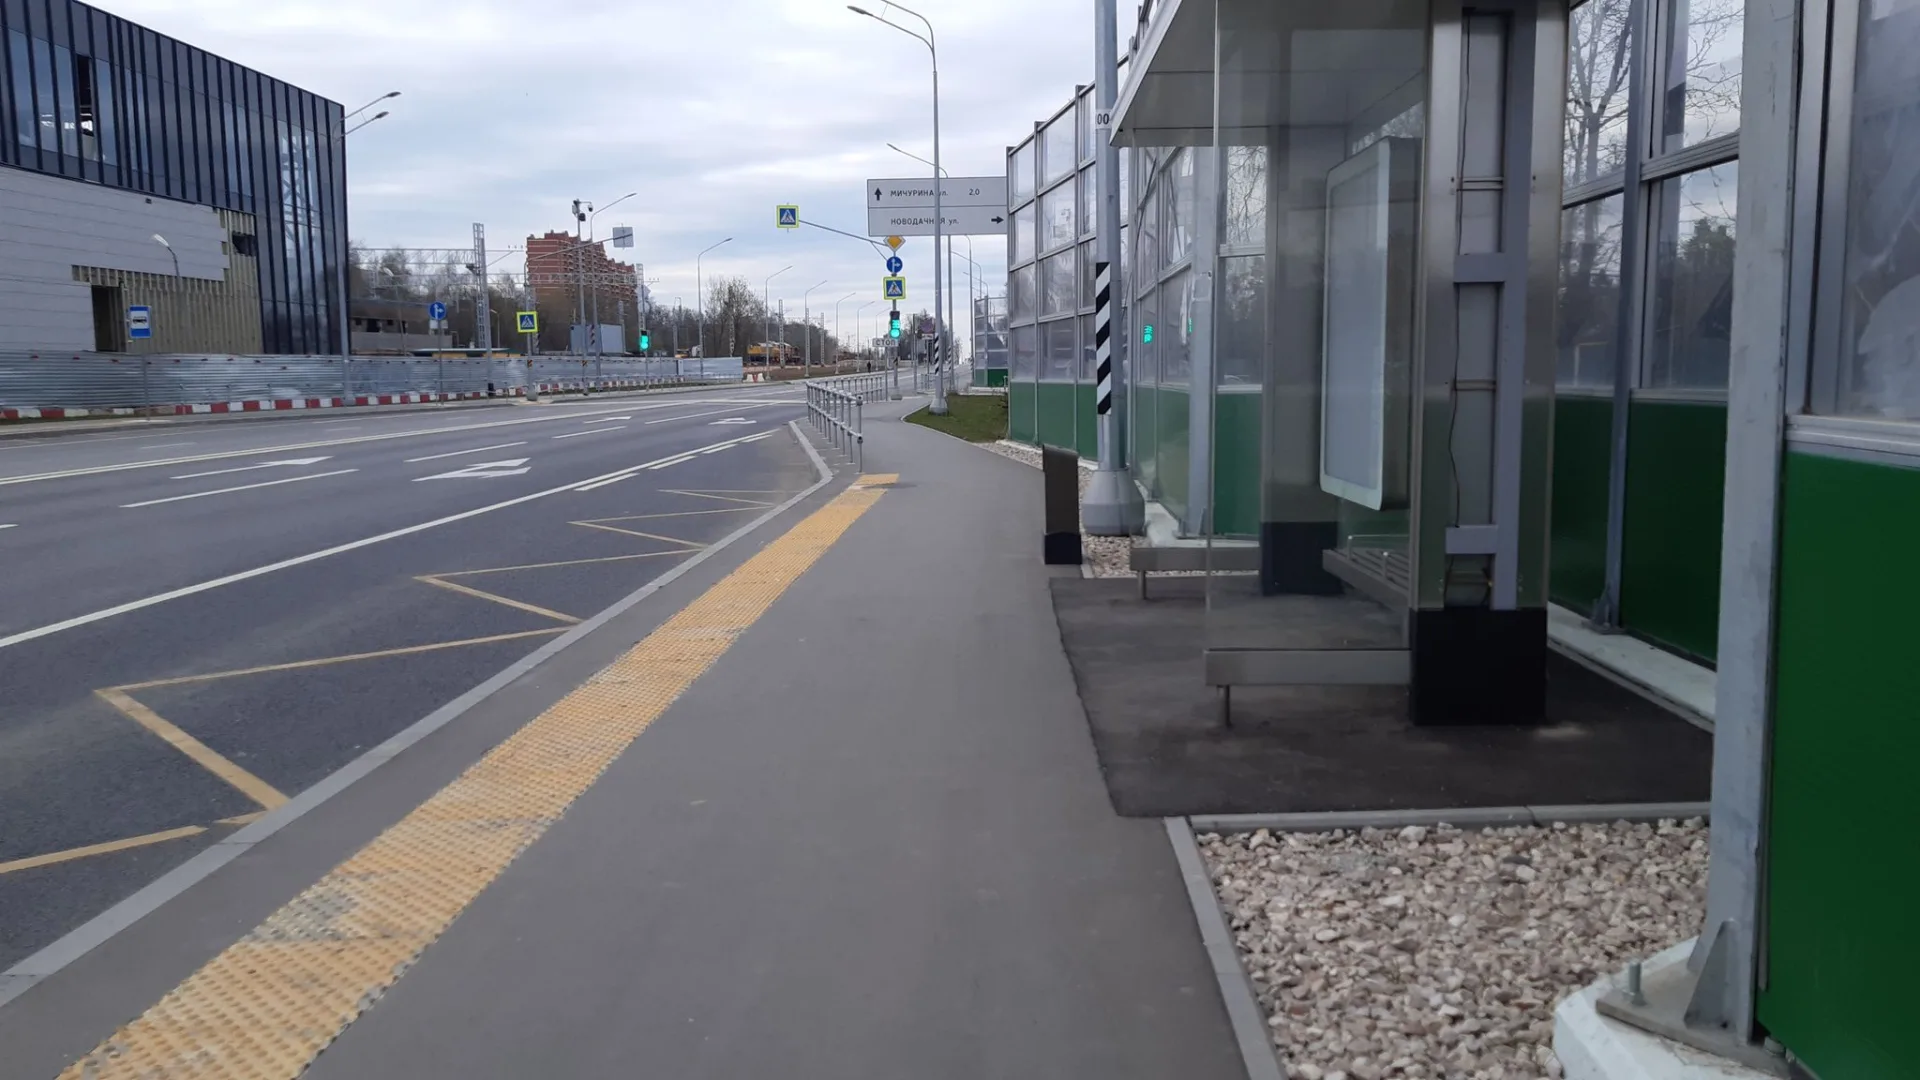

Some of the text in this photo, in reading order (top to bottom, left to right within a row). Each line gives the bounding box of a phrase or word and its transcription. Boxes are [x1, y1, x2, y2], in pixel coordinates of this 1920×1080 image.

[890, 189, 934, 197] МИЧУРИНА
[890, 217, 960, 226] НОВОДАЧНЯ ул.
